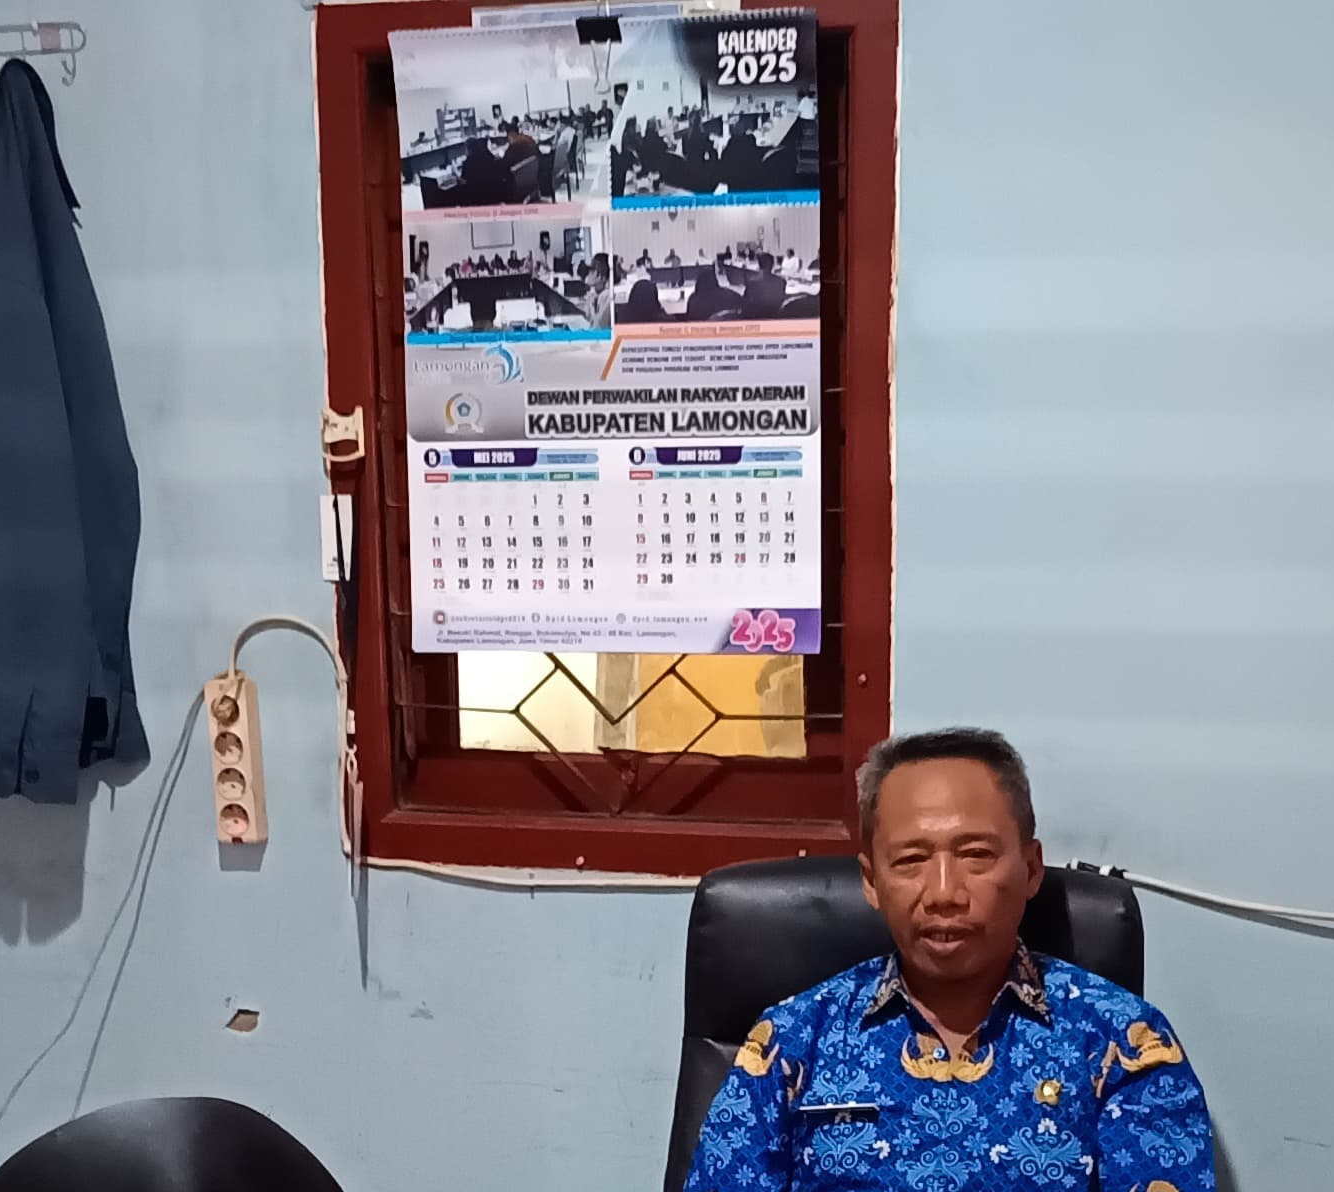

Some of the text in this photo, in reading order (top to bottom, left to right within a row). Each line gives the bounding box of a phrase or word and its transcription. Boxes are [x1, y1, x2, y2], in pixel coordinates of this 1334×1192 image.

[717, 27, 797, 54] KALENDER
[717, 54, 797, 85] 2025
[527, 386, 805, 405] DEWAN PERWAKILAN RAKYAT DAERAH
[528, 409, 808, 434] KABUPATEN LAMONGAN
[474, 452, 490, 464] MEI
[677, 450, 696, 462] JUNI
[533, 494, 589, 505] 1 2 3
[638, 494, 642, 504] 1
[662, 493, 667, 504] 2
[685, 493, 691, 504] 3
[710, 493, 715, 504] 4
[736, 493, 742, 503] 5
[787, 492, 791, 502] 7
[434, 515, 439, 526] 4
[459, 515, 464, 526] 5
[508, 515, 512, 526] 7
[582, 515, 592, 526] 10
[686, 513, 695, 523] 10
[710, 513, 719, 523] 11
[736, 512, 744, 523] 12
[760, 512, 769, 522] 13
[785, 512, 794, 522] 14
[432, 537, 440, 548] 11
[457, 537, 466, 548] 12
[482, 537, 491, 547] 13
[508, 537, 516, 547] 14
[533, 536, 542, 547] 15
[583, 536, 591, 547] 17
[636, 533, 645, 544] 15
[687, 533, 695, 544] 17
[735, 533, 745, 543] 19
[785, 532, 795, 543] 21
[459, 558, 468, 568] 19
[483, 558, 494, 569] 20
[507, 558, 517, 569] 21
[532, 558, 543, 569] 22
[557, 558, 568, 569] 23
[583, 558, 594, 568] 24
[636, 553, 647, 564] 22
[662, 553, 672, 563] 23
[686, 553, 697, 563] 24
[710, 553, 721, 563] 25
[759, 553, 769, 563] 27
[459, 579, 470, 589] 26
[482, 579, 492, 589] 27
[533, 579, 544, 590] 29
[558, 579, 570, 590] 30
[583, 579, 594, 590] 31
[661, 574, 673, 584] 30
